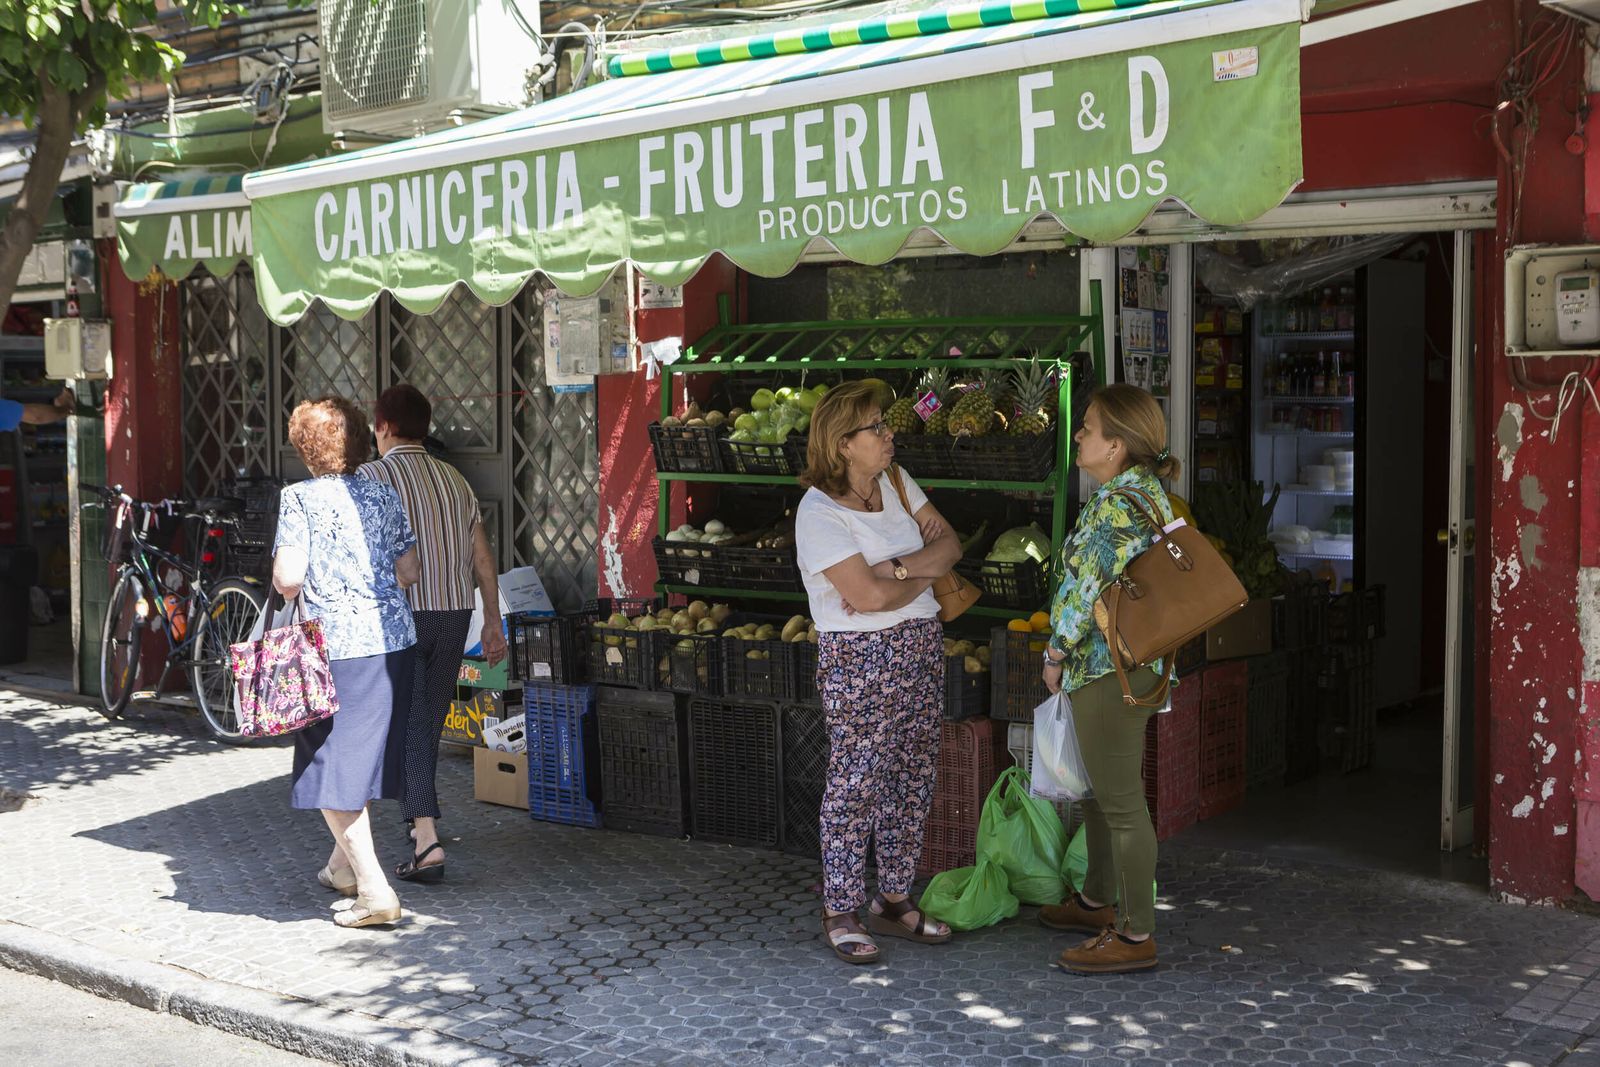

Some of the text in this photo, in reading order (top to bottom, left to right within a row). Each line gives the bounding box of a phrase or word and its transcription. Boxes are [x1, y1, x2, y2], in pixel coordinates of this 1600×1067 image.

[313, 152, 585, 262] CARNICERIA
[638, 91, 944, 219] FRUTERIA
[1017, 70, 1056, 169] F
[1077, 91, 1106, 131] &
[1128, 55, 1171, 155] D
[163, 210, 253, 260] ALIM
[758, 159, 1169, 244] PRODUCTOS LATINOS
